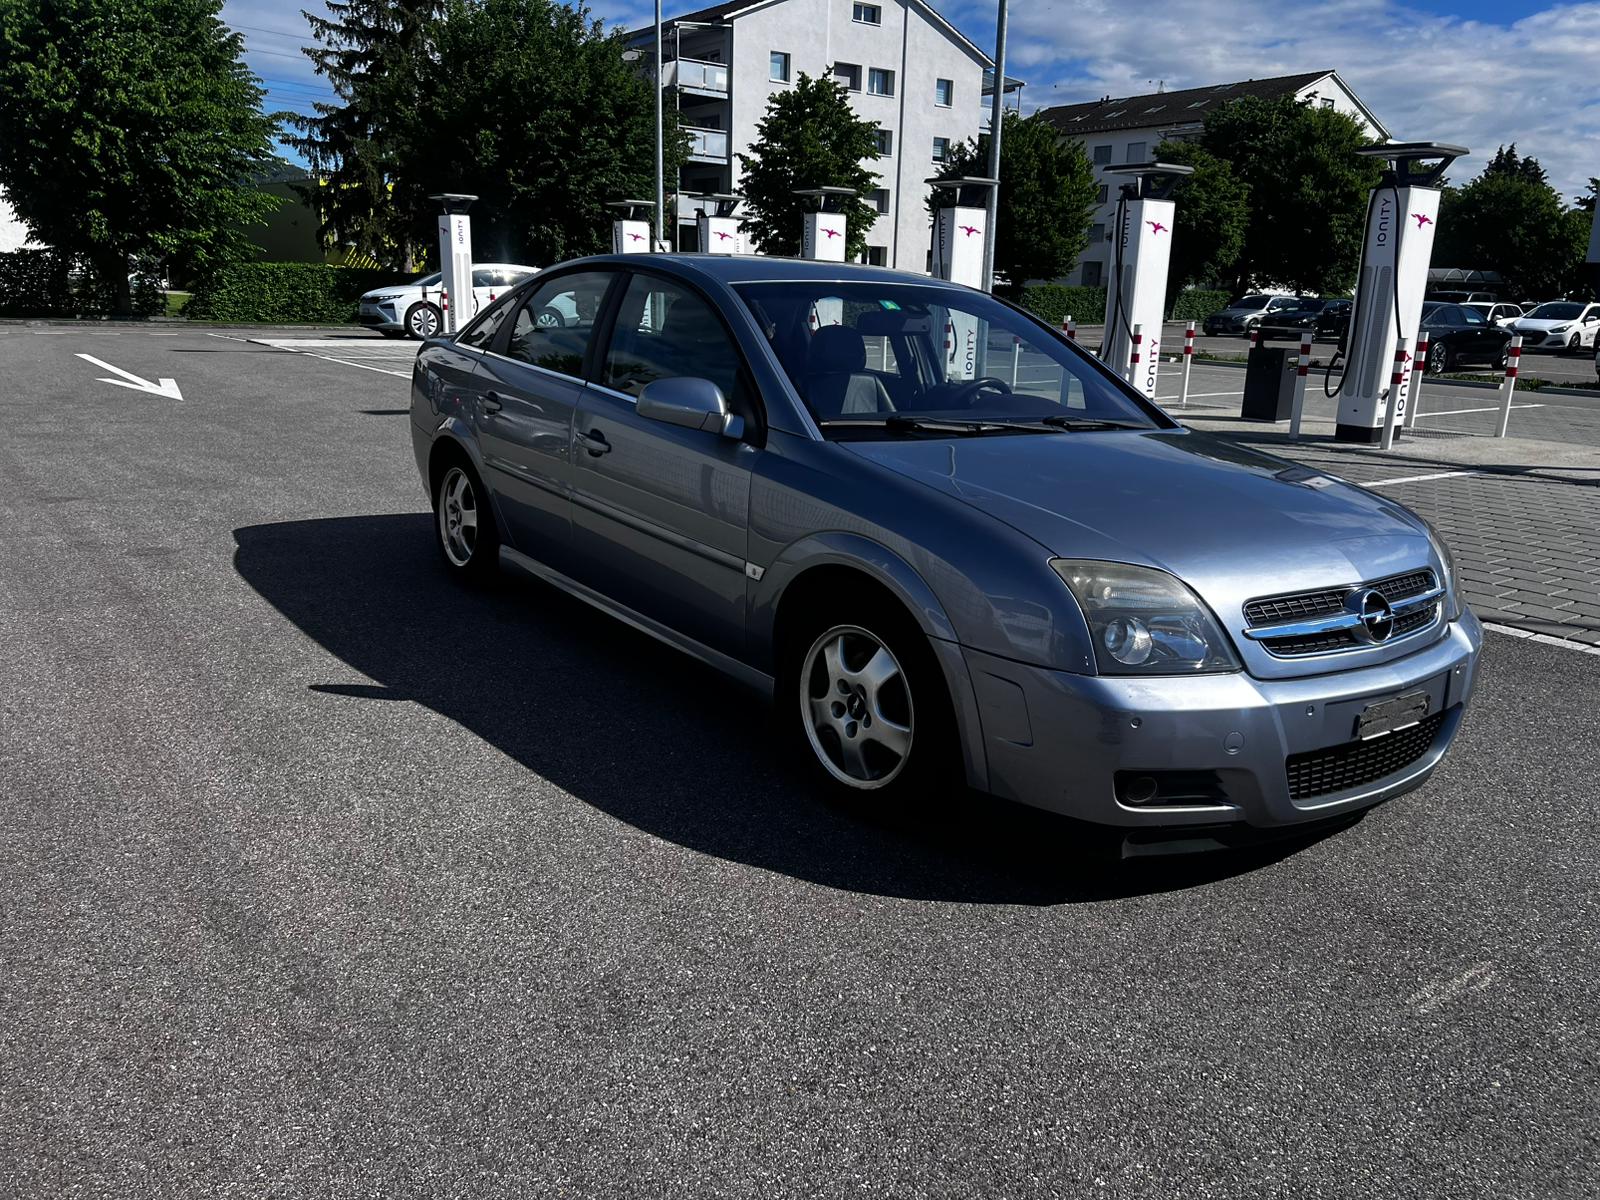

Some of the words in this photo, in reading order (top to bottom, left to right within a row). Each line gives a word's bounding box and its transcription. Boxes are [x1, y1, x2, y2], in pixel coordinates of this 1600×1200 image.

[1376, 198, 1392, 247] IONITY
[965, 329, 975, 375] IONITY
[1146, 338, 1158, 392] IONITY
[1396, 353, 1412, 417] IONITY
